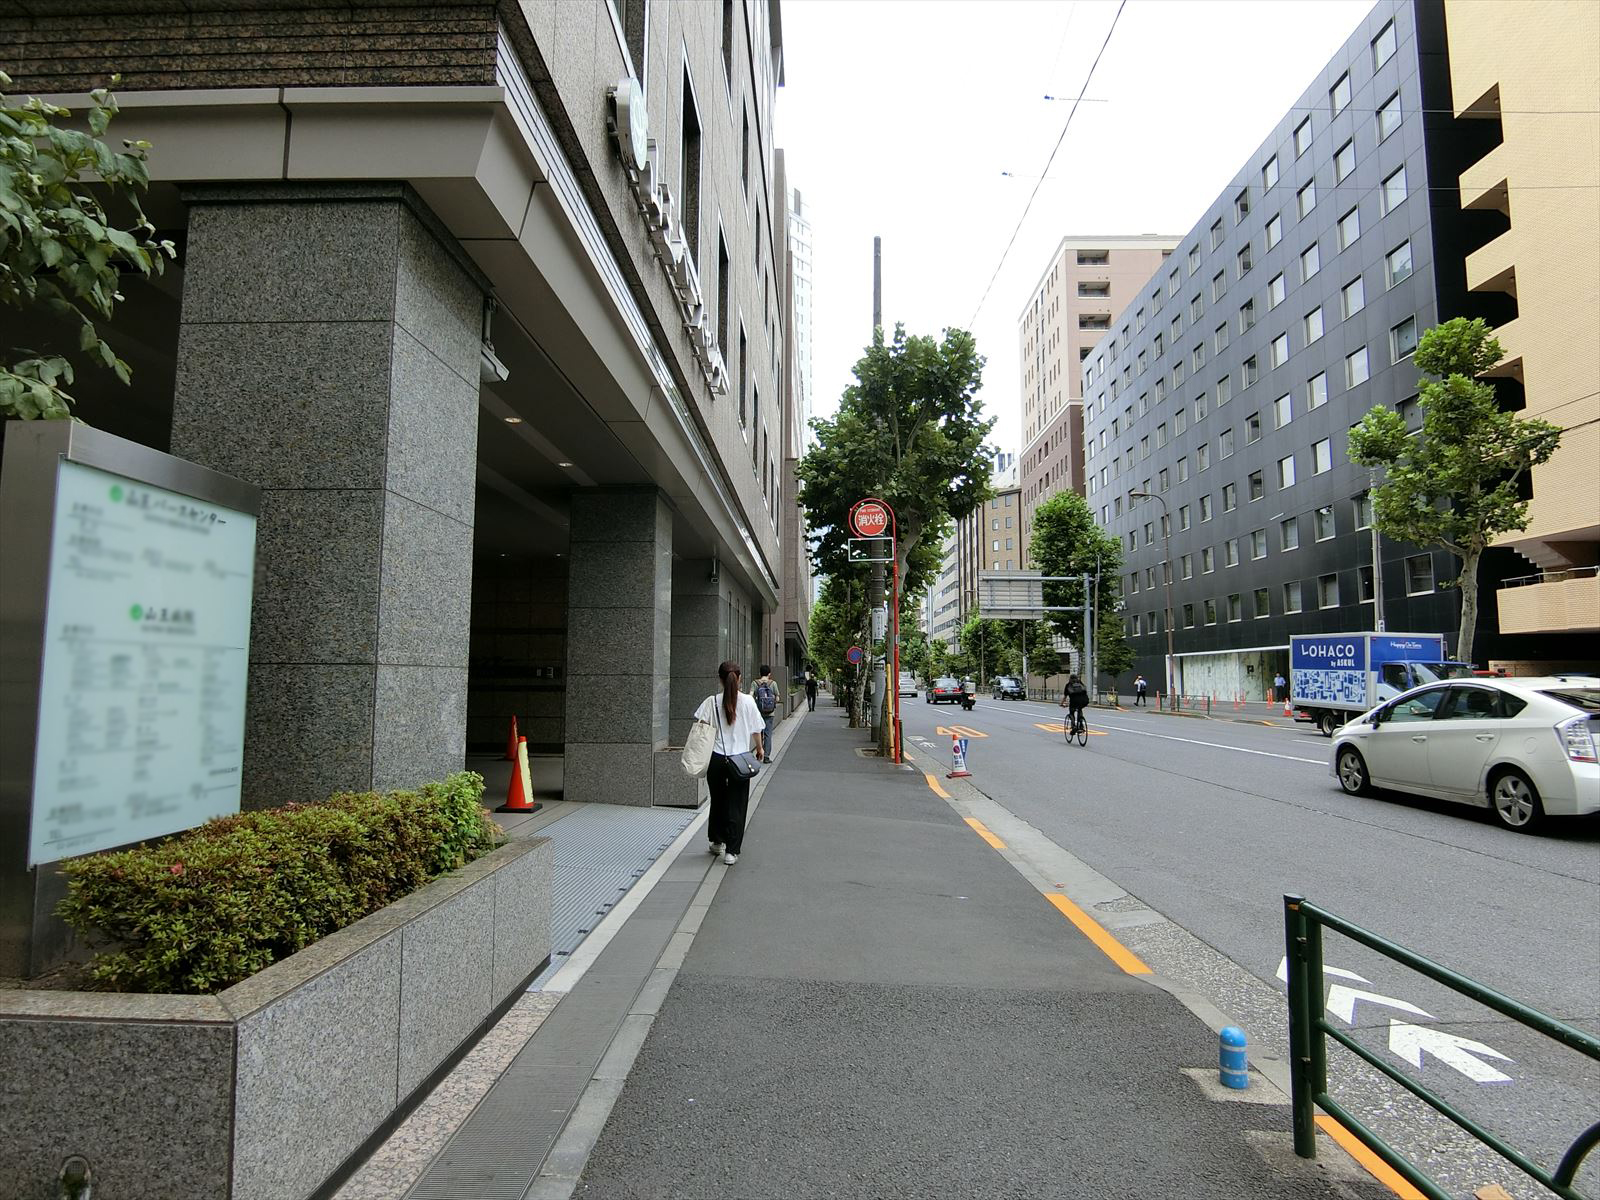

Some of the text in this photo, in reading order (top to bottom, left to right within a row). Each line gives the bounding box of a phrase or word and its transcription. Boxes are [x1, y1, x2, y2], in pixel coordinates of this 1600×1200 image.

[858, 513, 885, 527] 消火栓
[1301, 644, 1355, 657] LOHACO
[1337, 659, 1355, 667] ASKUL
